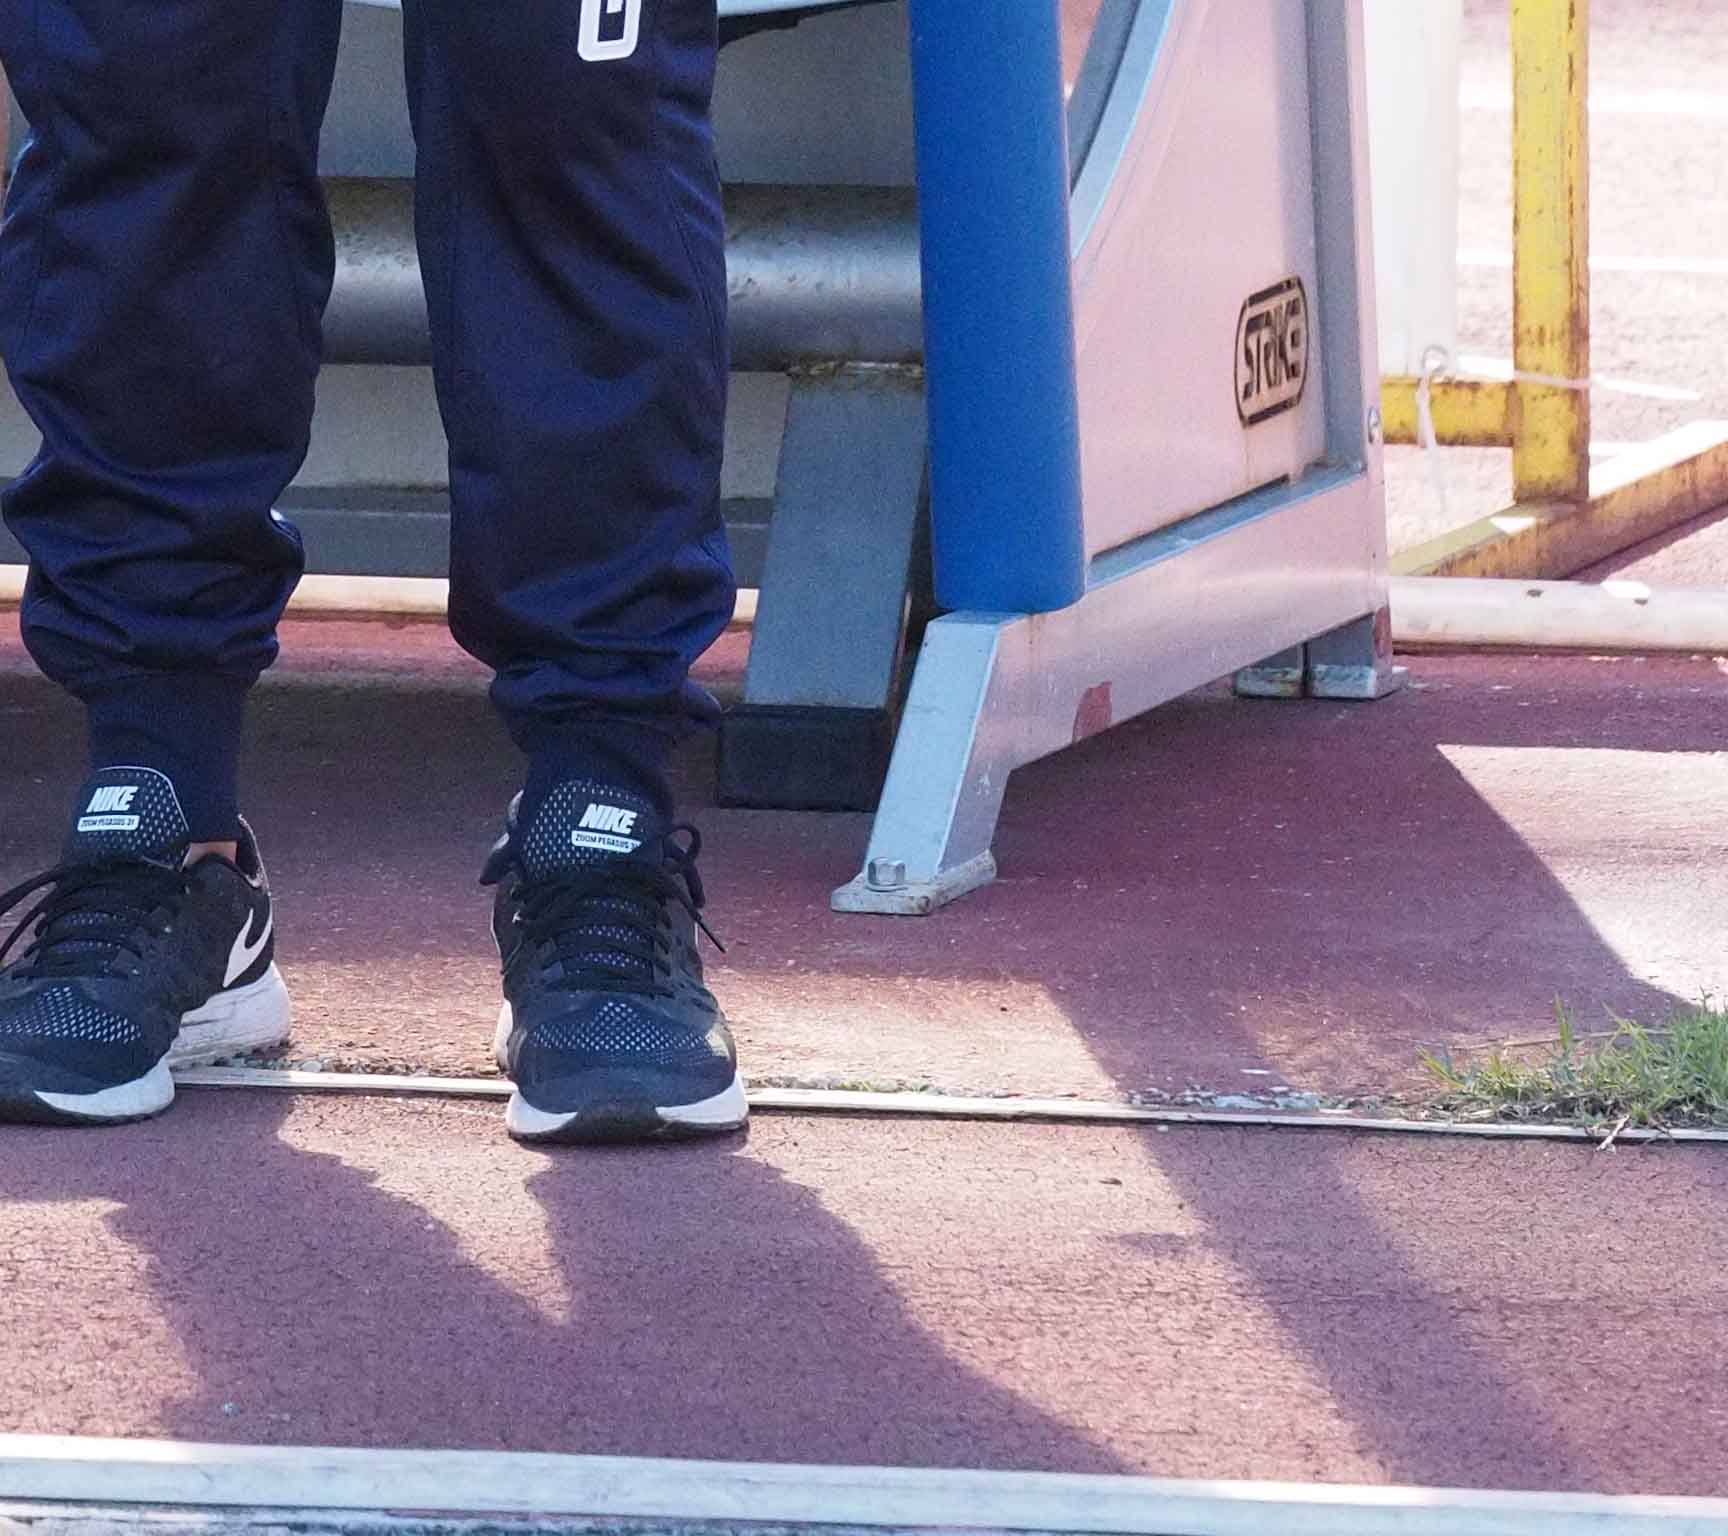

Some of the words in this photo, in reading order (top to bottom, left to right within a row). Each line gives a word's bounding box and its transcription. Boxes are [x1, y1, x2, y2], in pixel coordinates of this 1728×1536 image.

[1242, 297, 1302, 401] STRIKE
[85, 786, 139, 814] NIKE
[578, 803, 638, 835] NIKE
